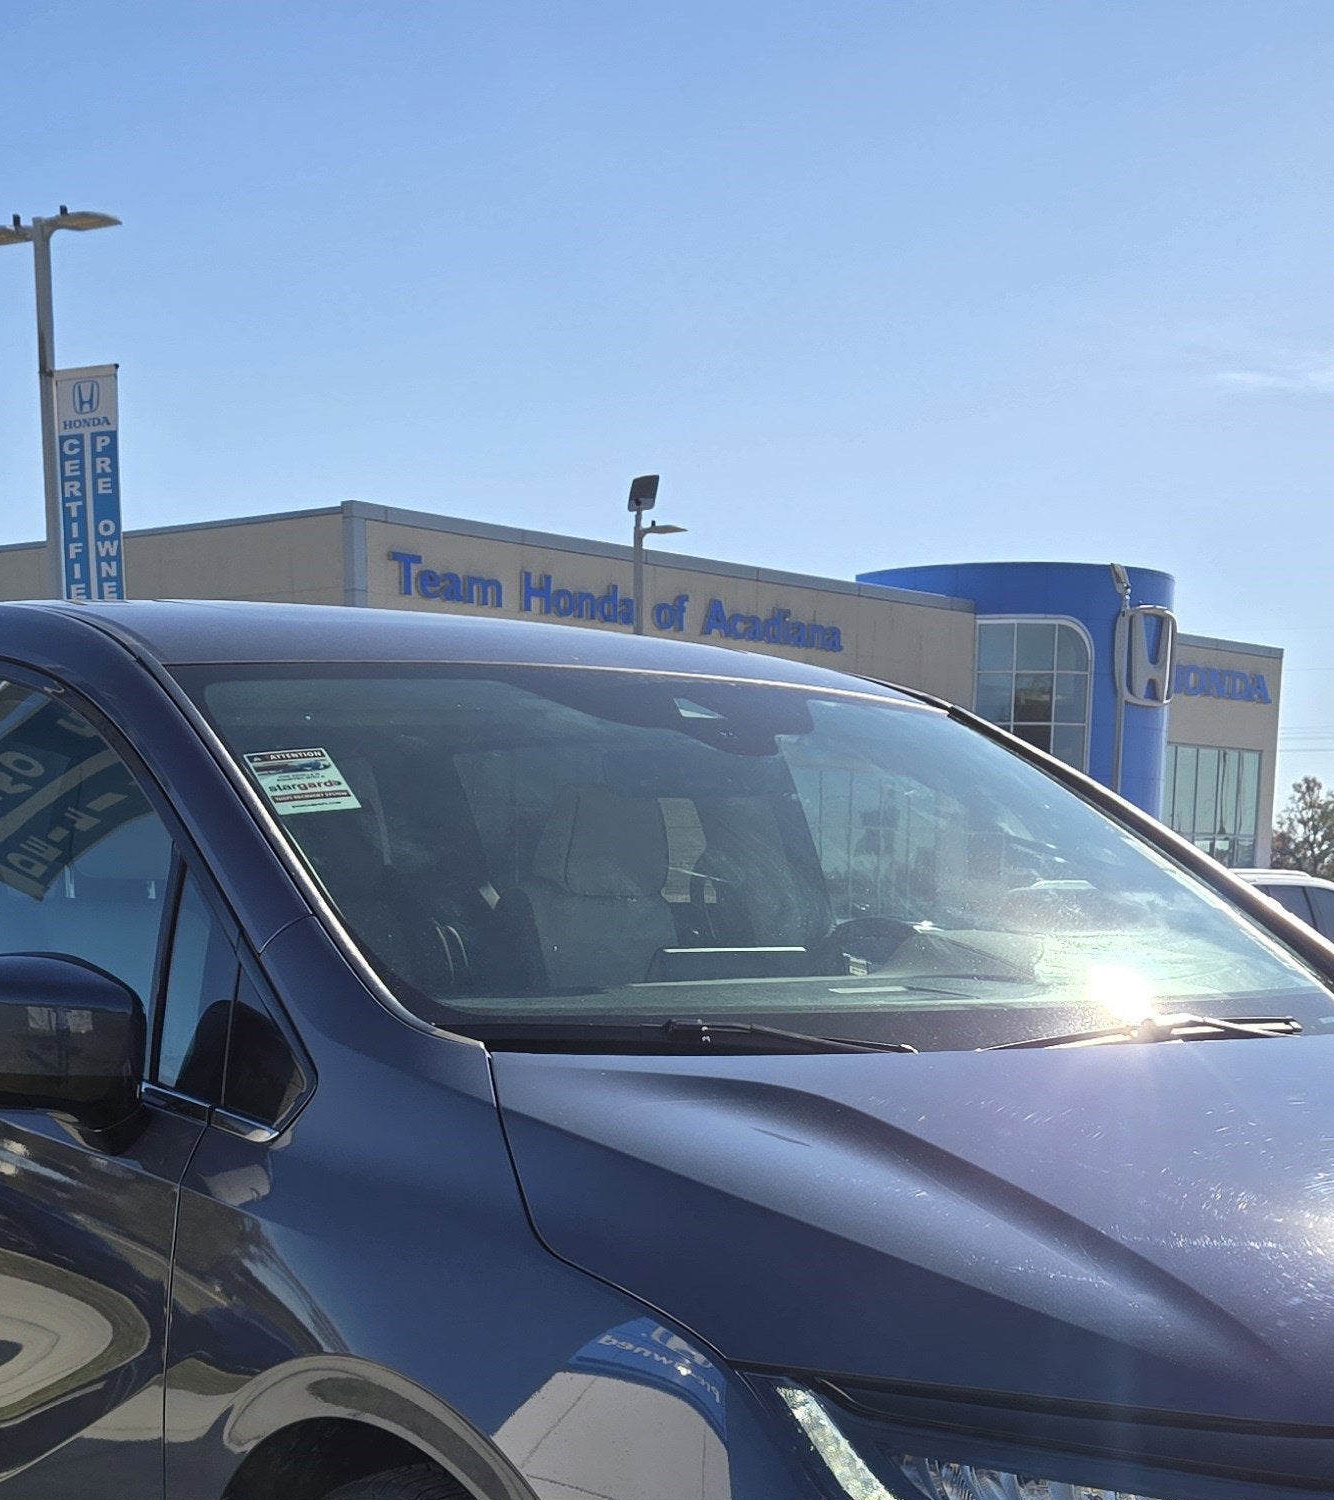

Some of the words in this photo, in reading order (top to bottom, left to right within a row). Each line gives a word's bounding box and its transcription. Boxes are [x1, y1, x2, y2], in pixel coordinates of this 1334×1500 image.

[63, 416, 111, 430] HONDA
[95, 435, 113, 494] PRE
[62, 438, 87, 600] CERTIFIE
[97, 519, 119, 600] OWNE
[388, 551, 503, 609] Team
[522, 569, 634, 626] Honda
[652, 594, 689, 633] of
[702, 599, 843, 653] Acadiana
[270, 750, 322, 761] ATTENTION
